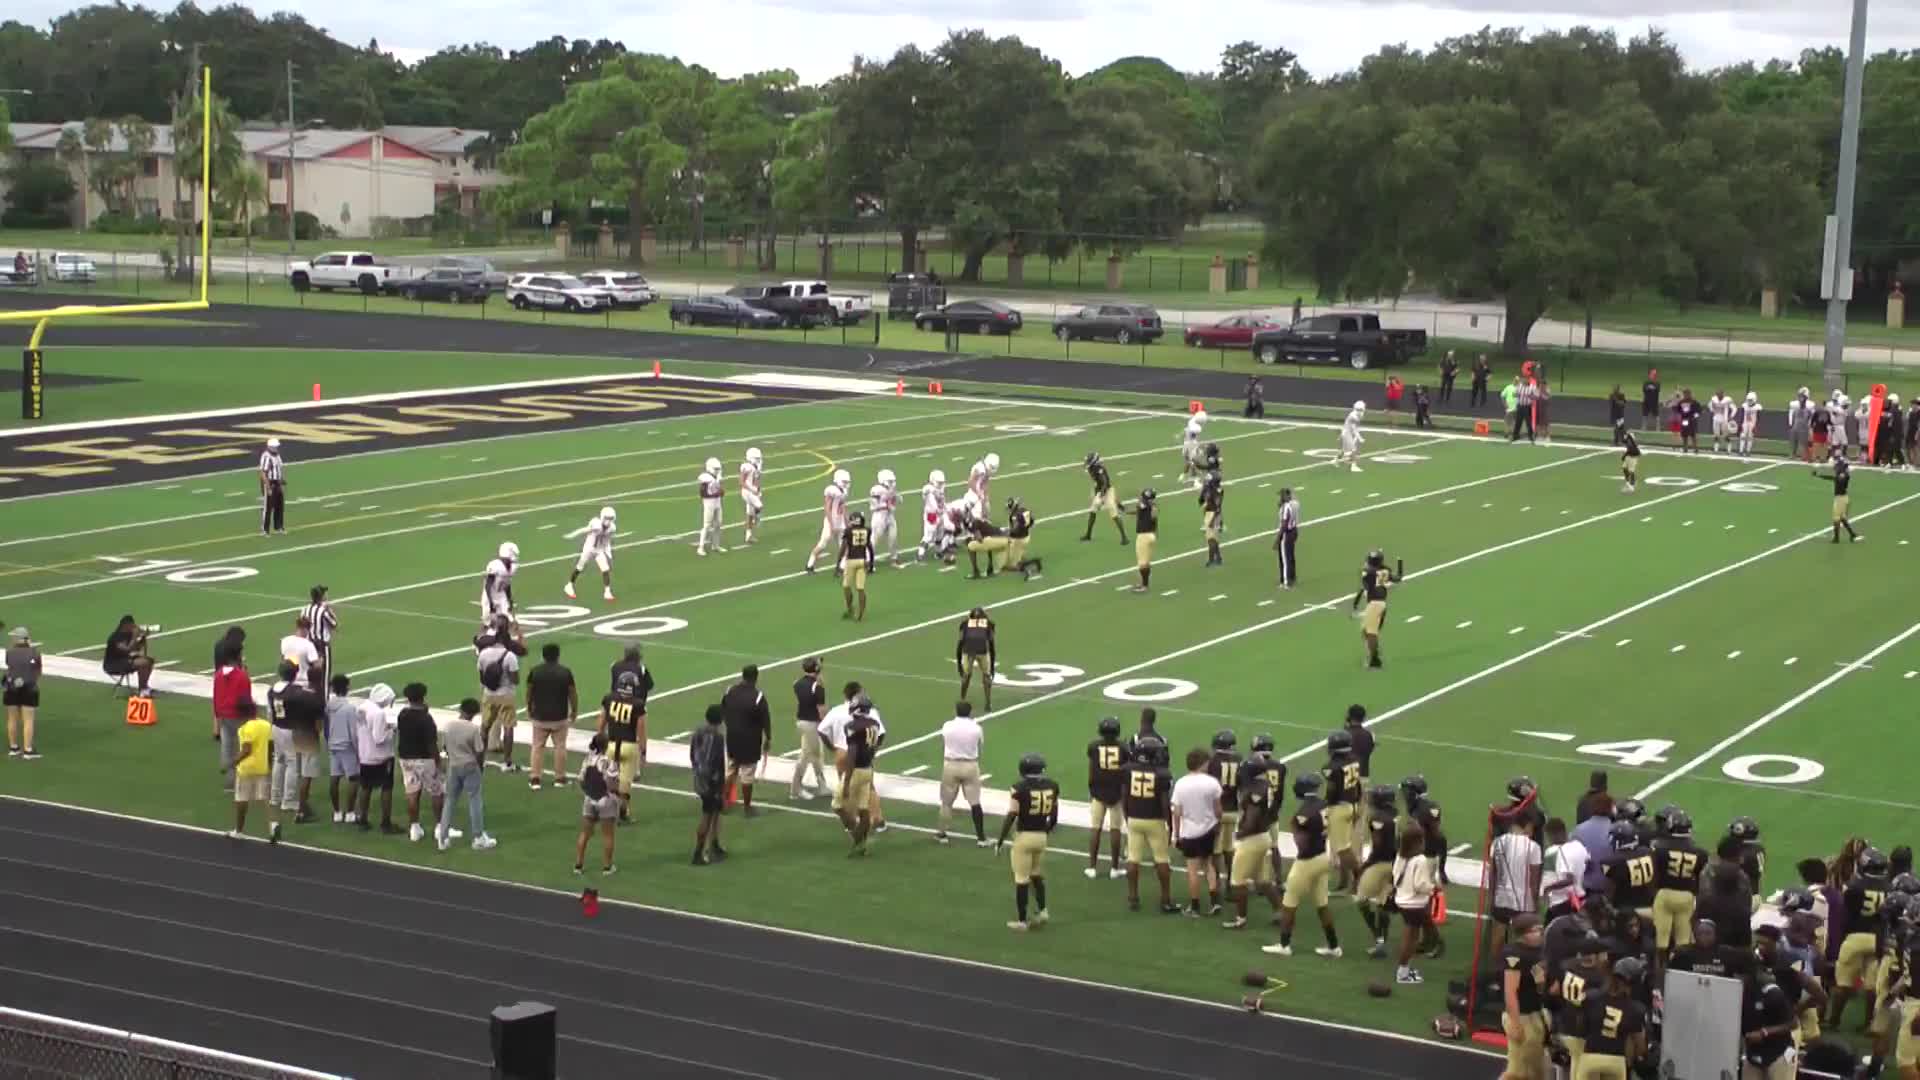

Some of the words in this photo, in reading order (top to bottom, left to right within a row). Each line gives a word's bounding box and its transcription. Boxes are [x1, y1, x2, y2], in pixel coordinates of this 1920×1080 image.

[991, 663, 1199, 700] 30
[129, 700, 149, 721] 20
[610, 701, 632, 723] 40
[1098, 745, 1120, 769] 12
[1575, 739, 1825, 784] 40
[1130, 771, 1155, 797] 62
[1220, 761, 1238, 785] 11
[1029, 790, 1053, 815] 36
[1627, 855, 1654, 886] 60
[1667, 850, 1698, 878] 32
